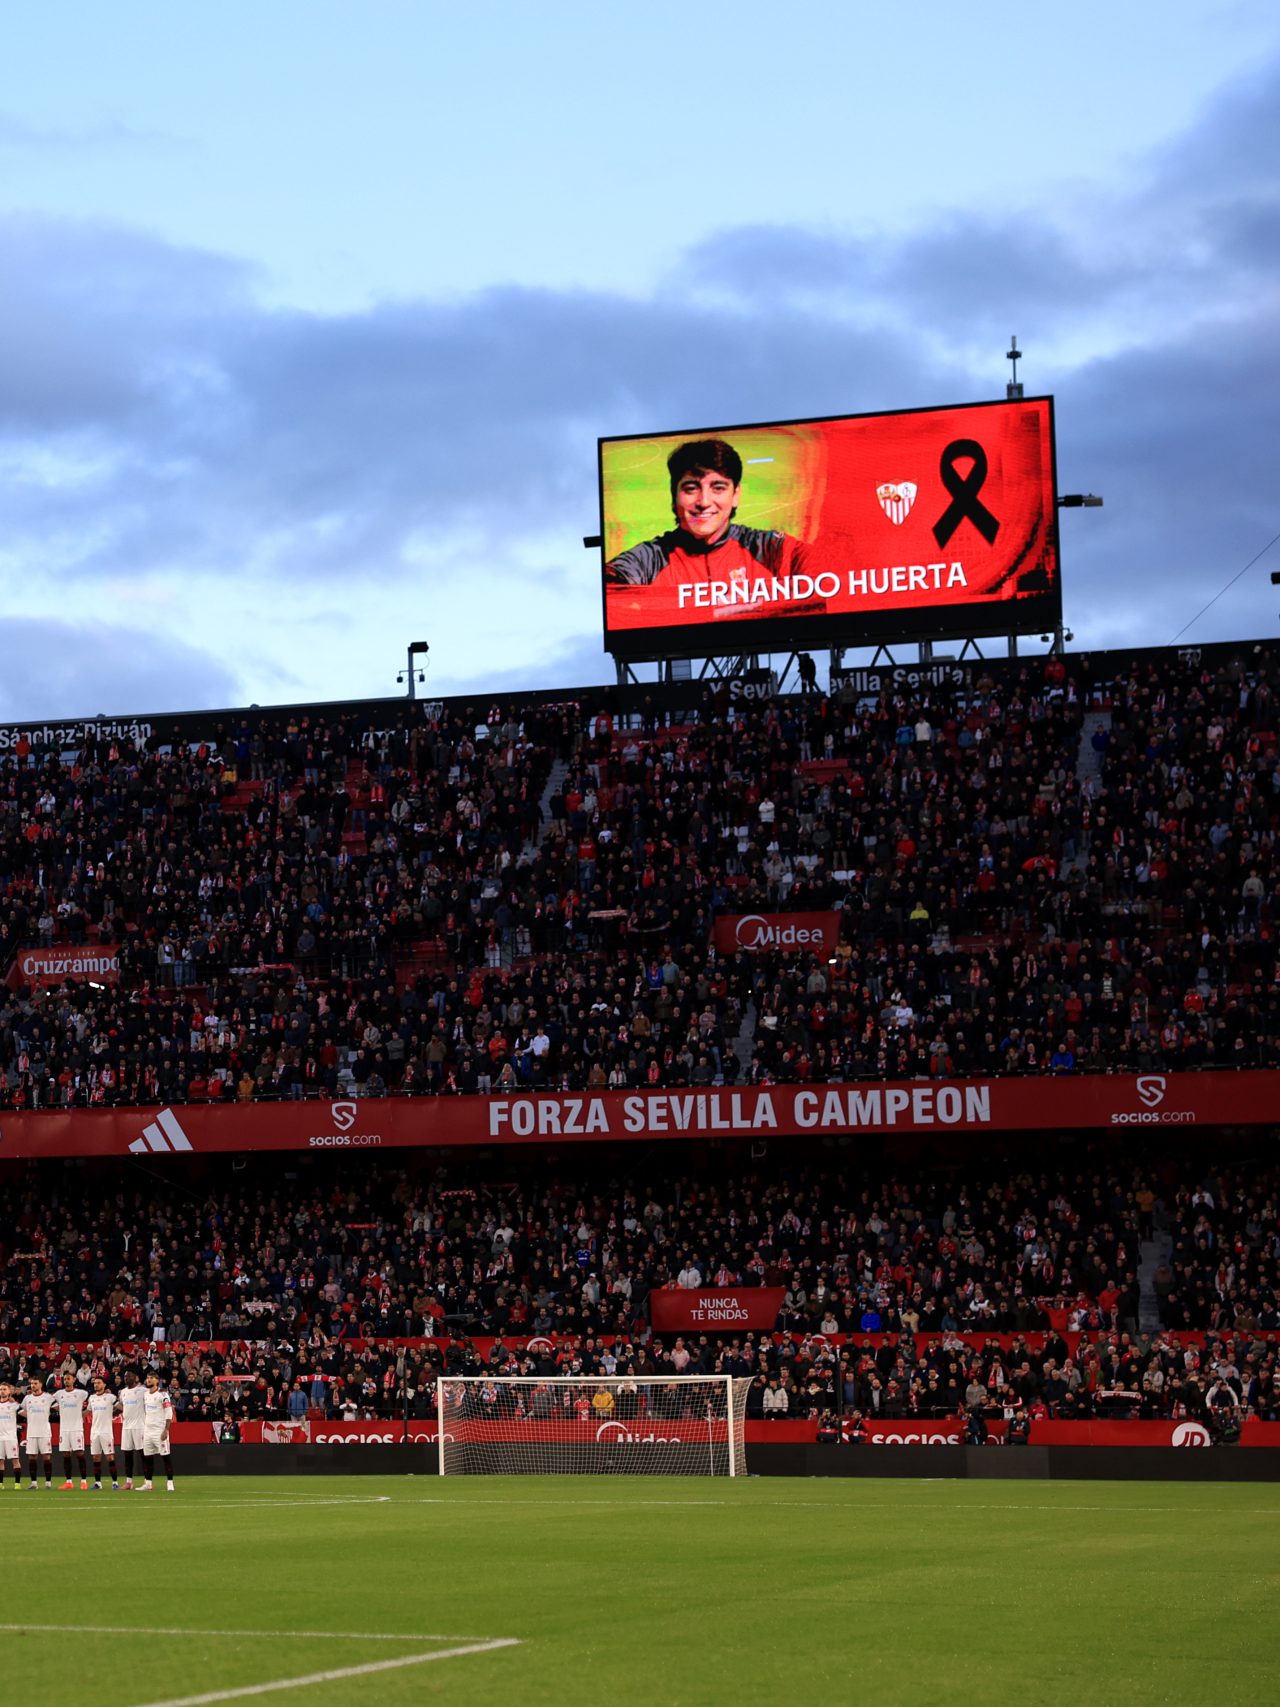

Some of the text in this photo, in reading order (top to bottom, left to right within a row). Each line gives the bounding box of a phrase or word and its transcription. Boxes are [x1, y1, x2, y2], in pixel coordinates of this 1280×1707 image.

[678, 562, 967, 608] FERNANDO HUERTA
[830, 672, 881, 694] evilla
[23, 956, 120, 976] Cruzcampo
[489, 1086, 991, 1136] FORZA SEVILLA CAMPEON
[700, 1298, 738, 1309] NUNCA
[690, 1309, 748, 1320] TE RINDAS
